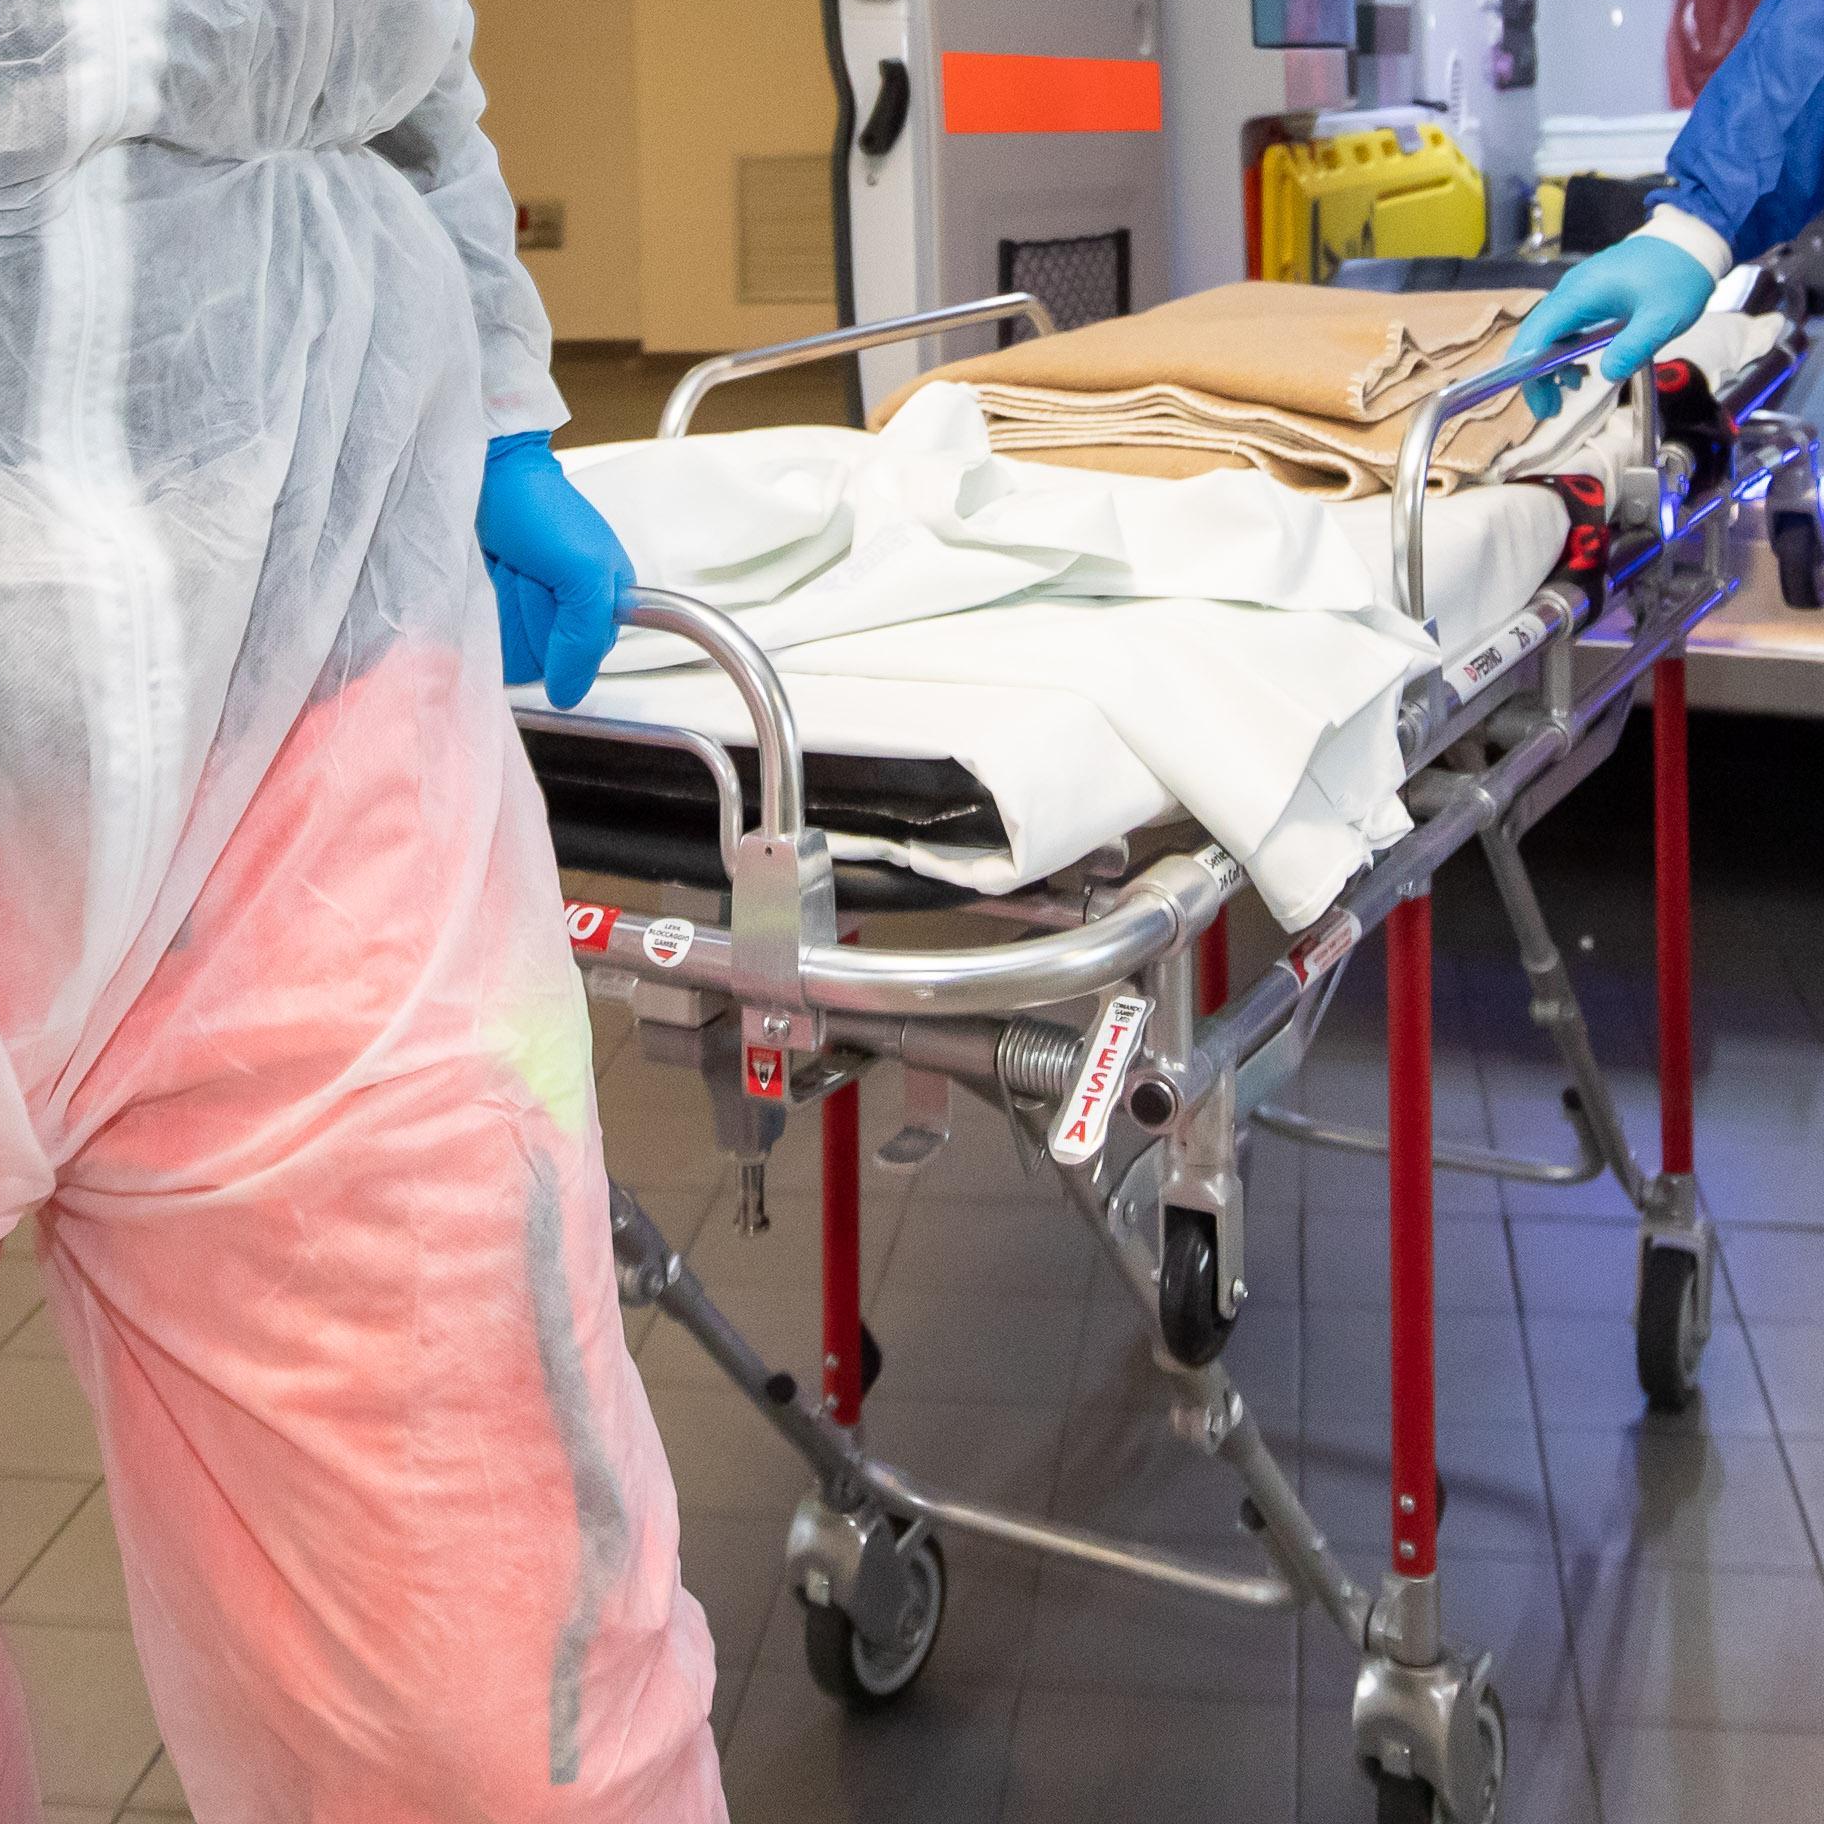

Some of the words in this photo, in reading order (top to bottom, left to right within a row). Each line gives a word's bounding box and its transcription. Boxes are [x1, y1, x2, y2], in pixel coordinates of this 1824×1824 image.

[648, 928, 690, 942] BLOCCAGGIO
[654, 939, 678, 949] GAMBE
[1064, 1024, 1128, 1143] TESTA
